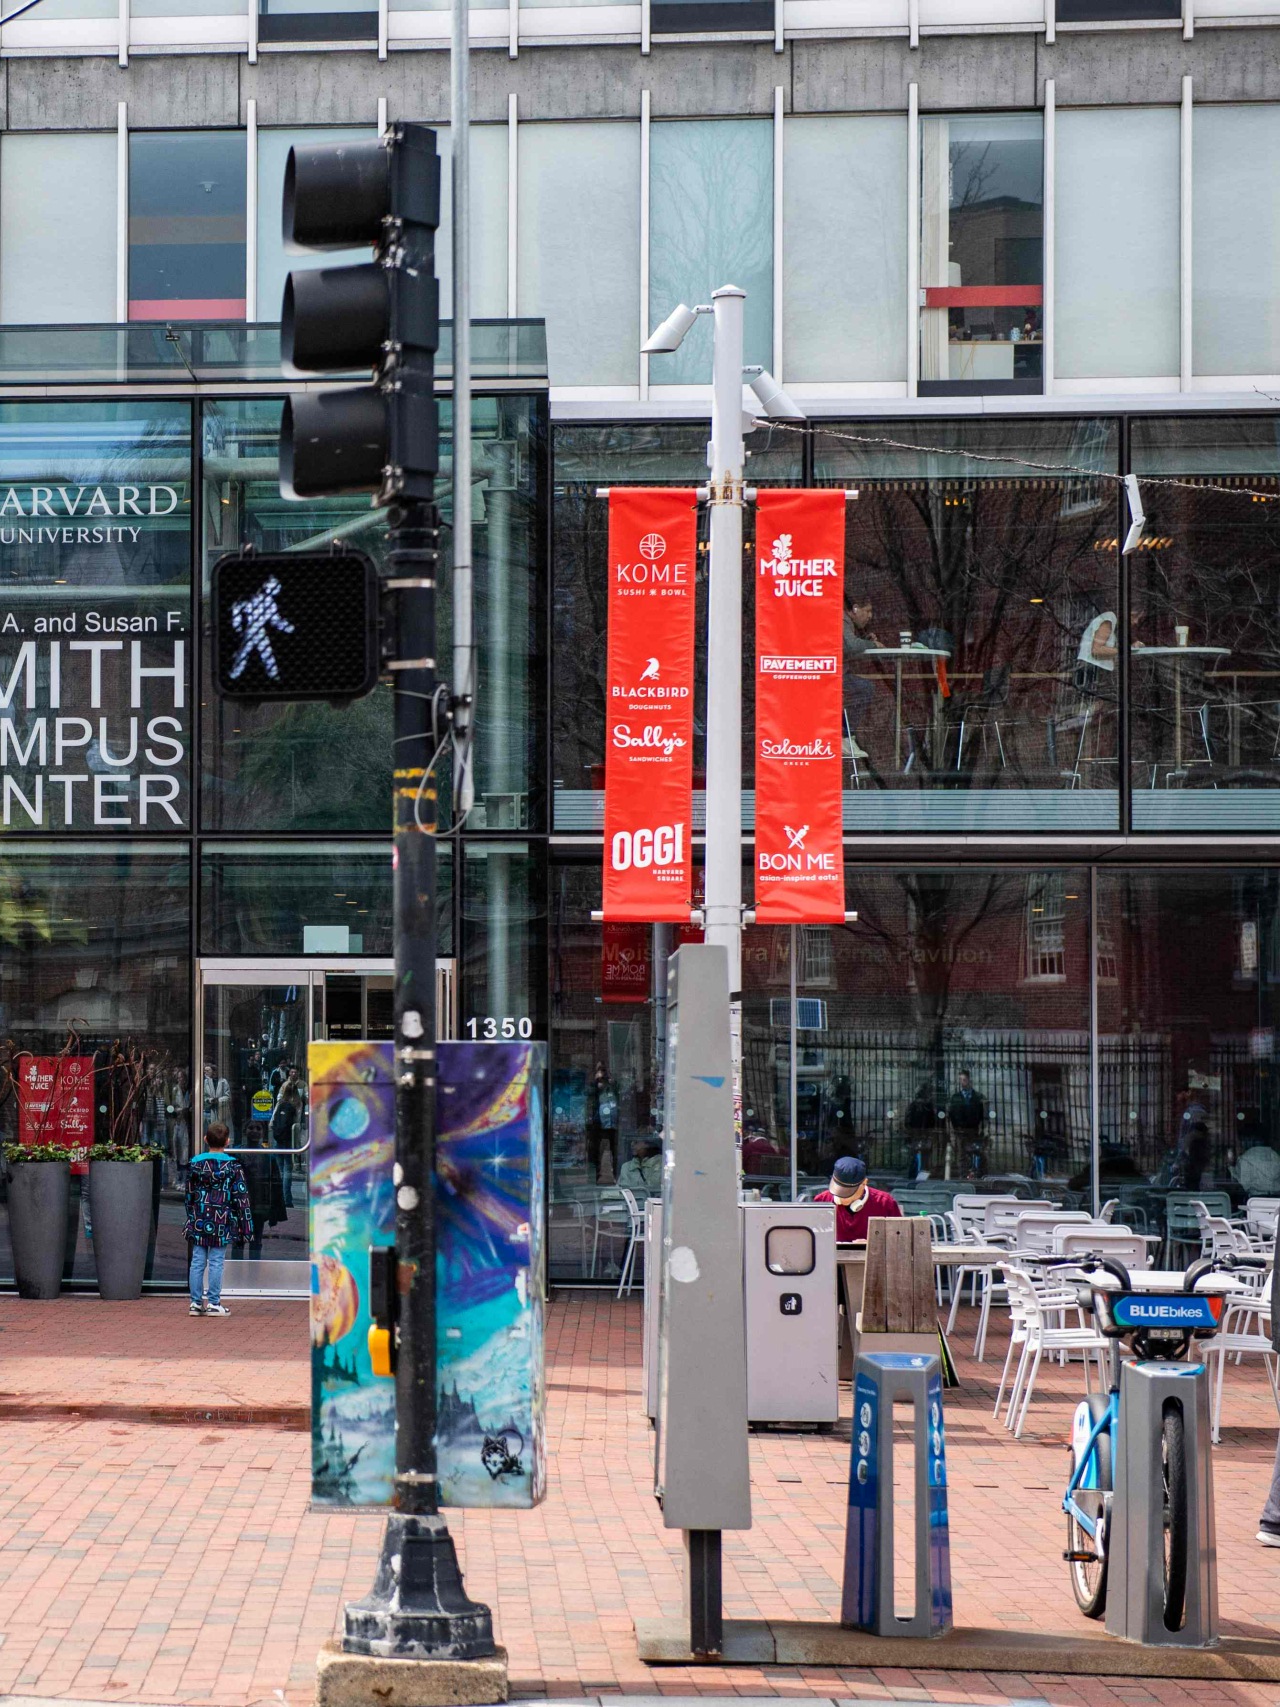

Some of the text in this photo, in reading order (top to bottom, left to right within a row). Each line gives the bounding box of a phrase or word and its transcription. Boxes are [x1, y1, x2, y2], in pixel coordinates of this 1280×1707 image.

[0, 526, 142, 544] UNIVERSITY
[617, 563, 687, 583] KOME
[760, 558, 838, 577] MOTHER
[617, 588, 645, 596] SUSHI
[661, 588, 687, 596] BOWL
[1, 613, 25, 633] A.
[34, 612, 76, 633] and
[84, 612, 158, 632] Susan
[167, 611, 185, 632] F.
[763, 659, 833, 670] PAVEMENT
[612, 686, 689, 698] BLACKBIRD
[612, 724, 687, 755] Sally's
[761, 738, 834, 757] Saloniki
[612, 823, 684, 871] OGGI
[759, 853, 835, 870] BON ME
[759, 873, 838, 882] asian-inspired eats!
[466, 1017, 533, 1038] 1350
[1130, 1305, 1203, 1318] BLUEbikes
